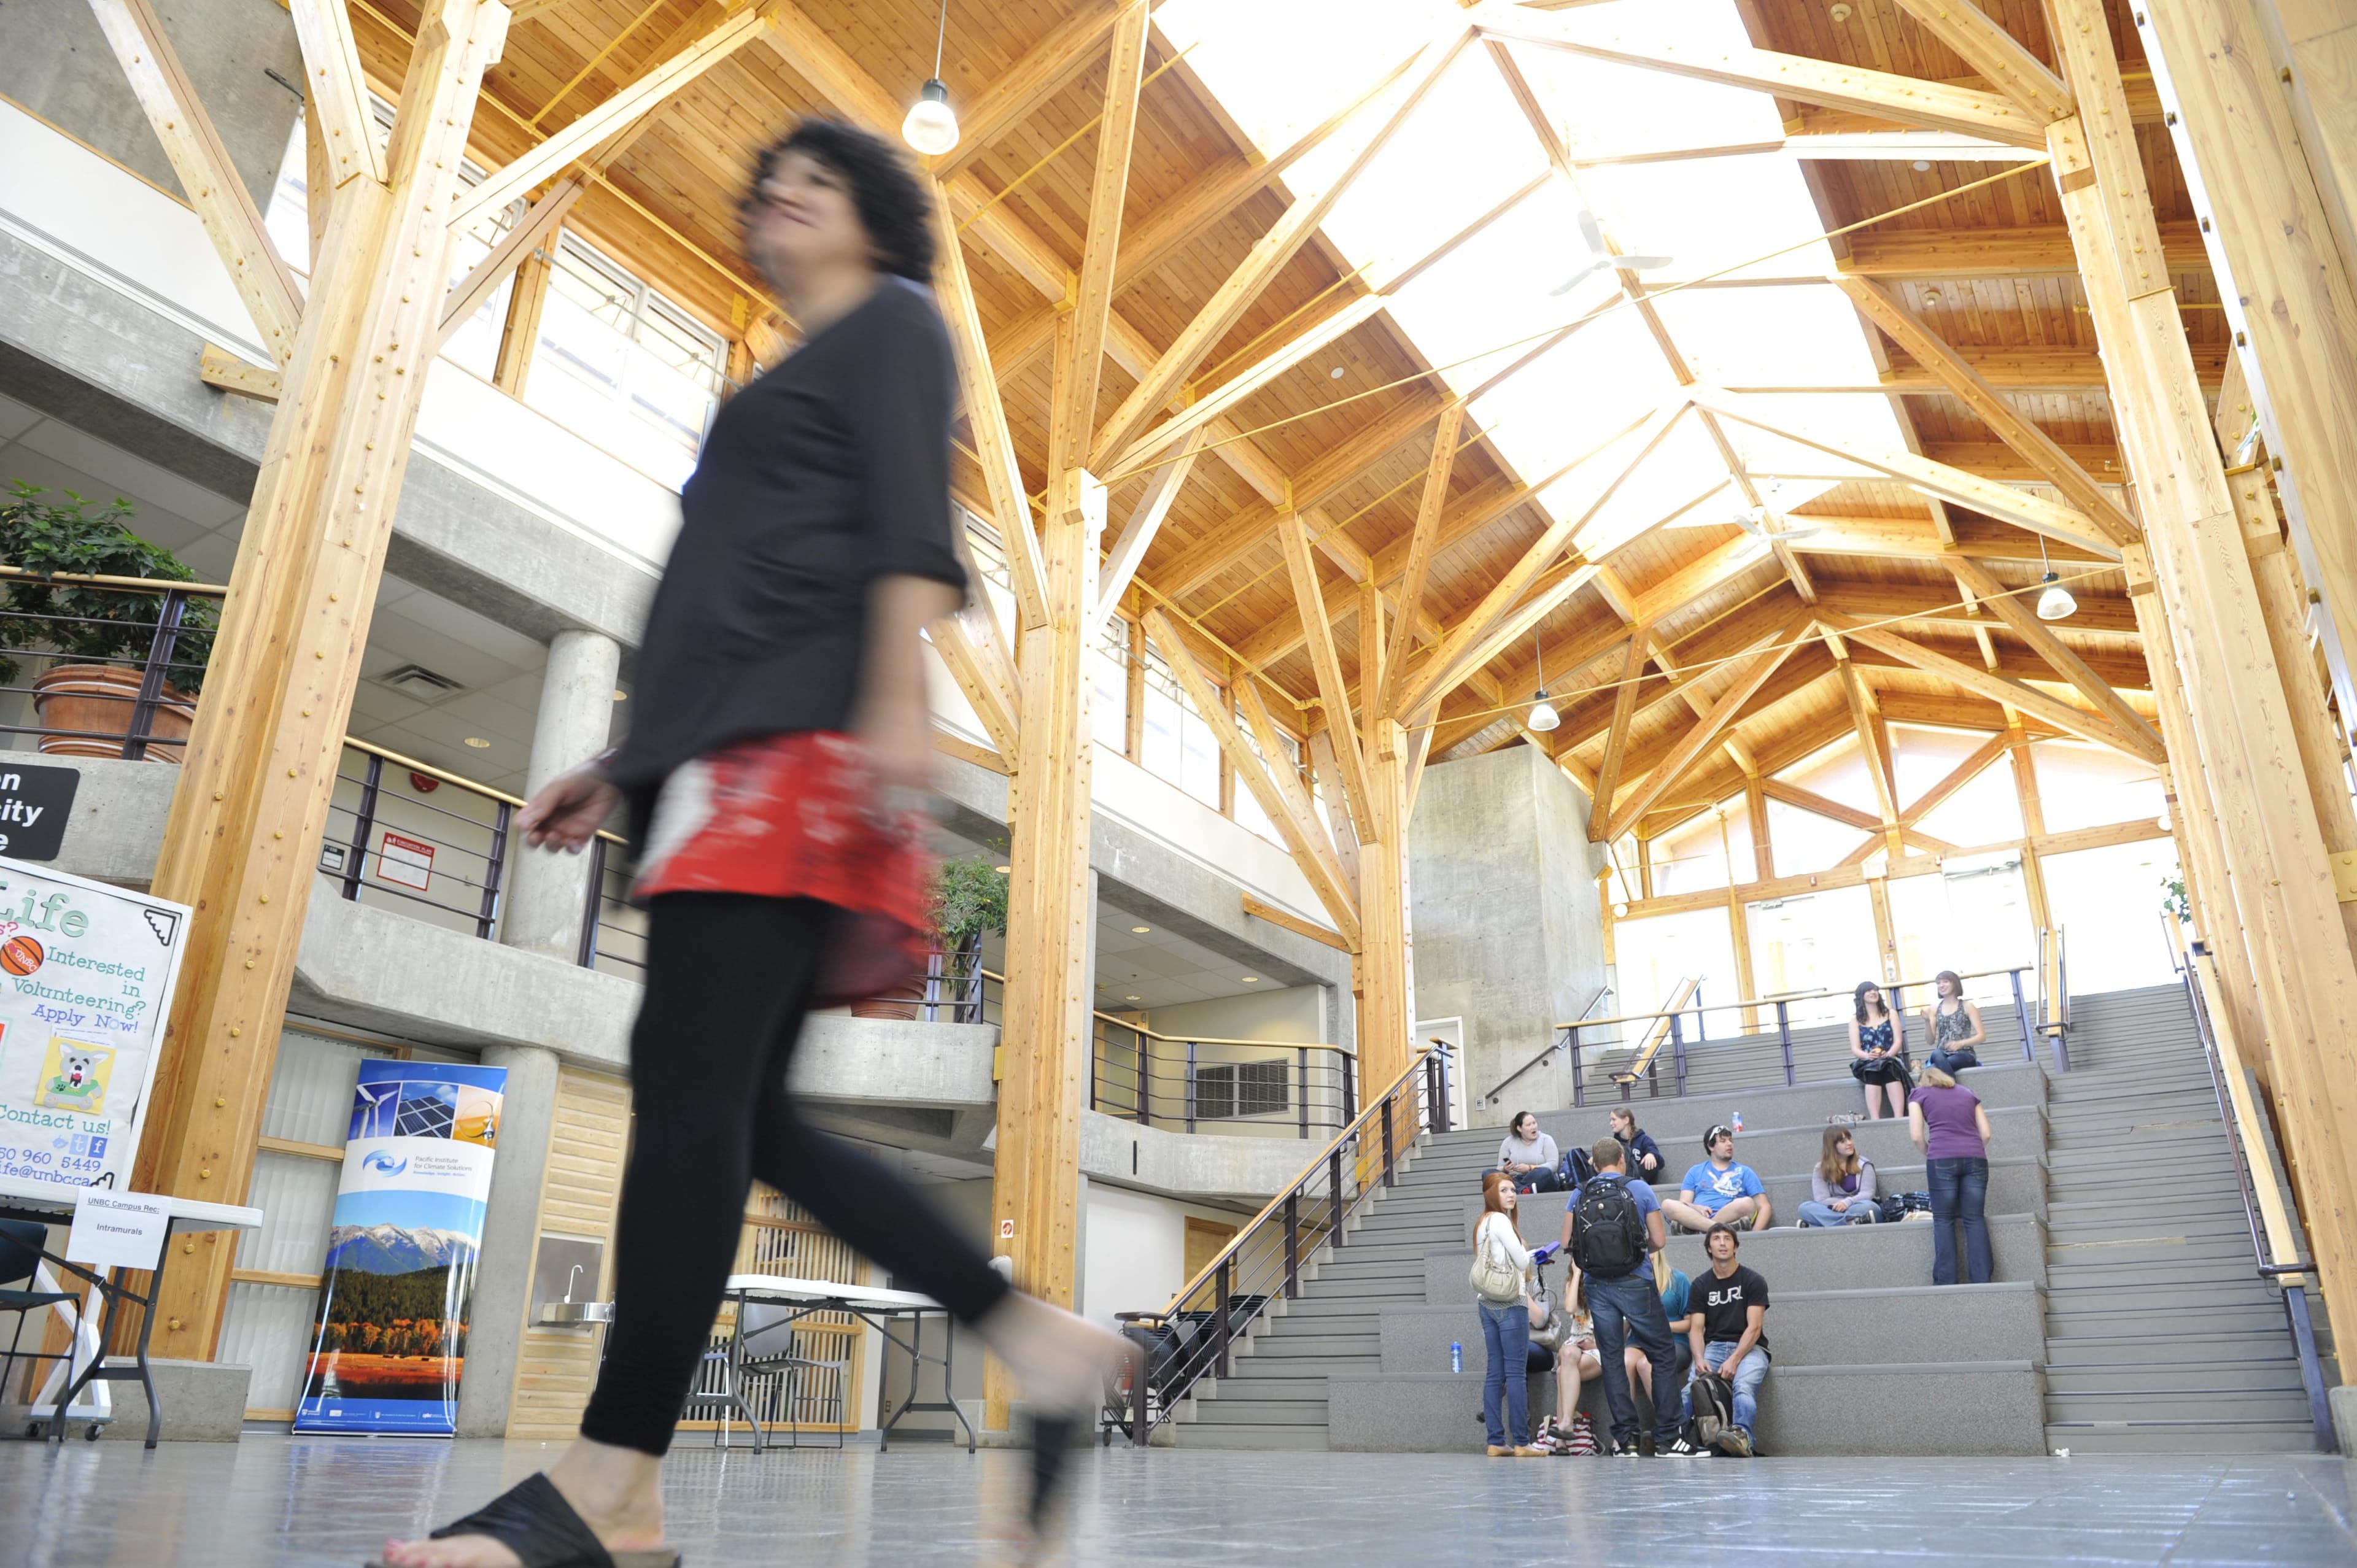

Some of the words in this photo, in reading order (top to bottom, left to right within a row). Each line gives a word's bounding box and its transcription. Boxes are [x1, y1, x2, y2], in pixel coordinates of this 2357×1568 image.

[0, 774, 21, 790] n
[0, 798, 44, 827] ity
[15, 949, 37, 972] UNBC
[46, 946, 146, 982] Interested
[12, 977, 147, 1020] Volunteering?
[122, 981, 141, 998] in
[31, 1004, 86, 1026] Apply
[83, 1119, 111, 1135] us!
[23, 1149, 52, 1164] 960
[61, 1156, 101, 1172] 5449
[88, 1197, 110, 1207] UNBC
[112, 1200, 141, 1211] Campus
[144, 1205, 160, 1213] Rec:
[96, 1224, 142, 1235] Intramurals
